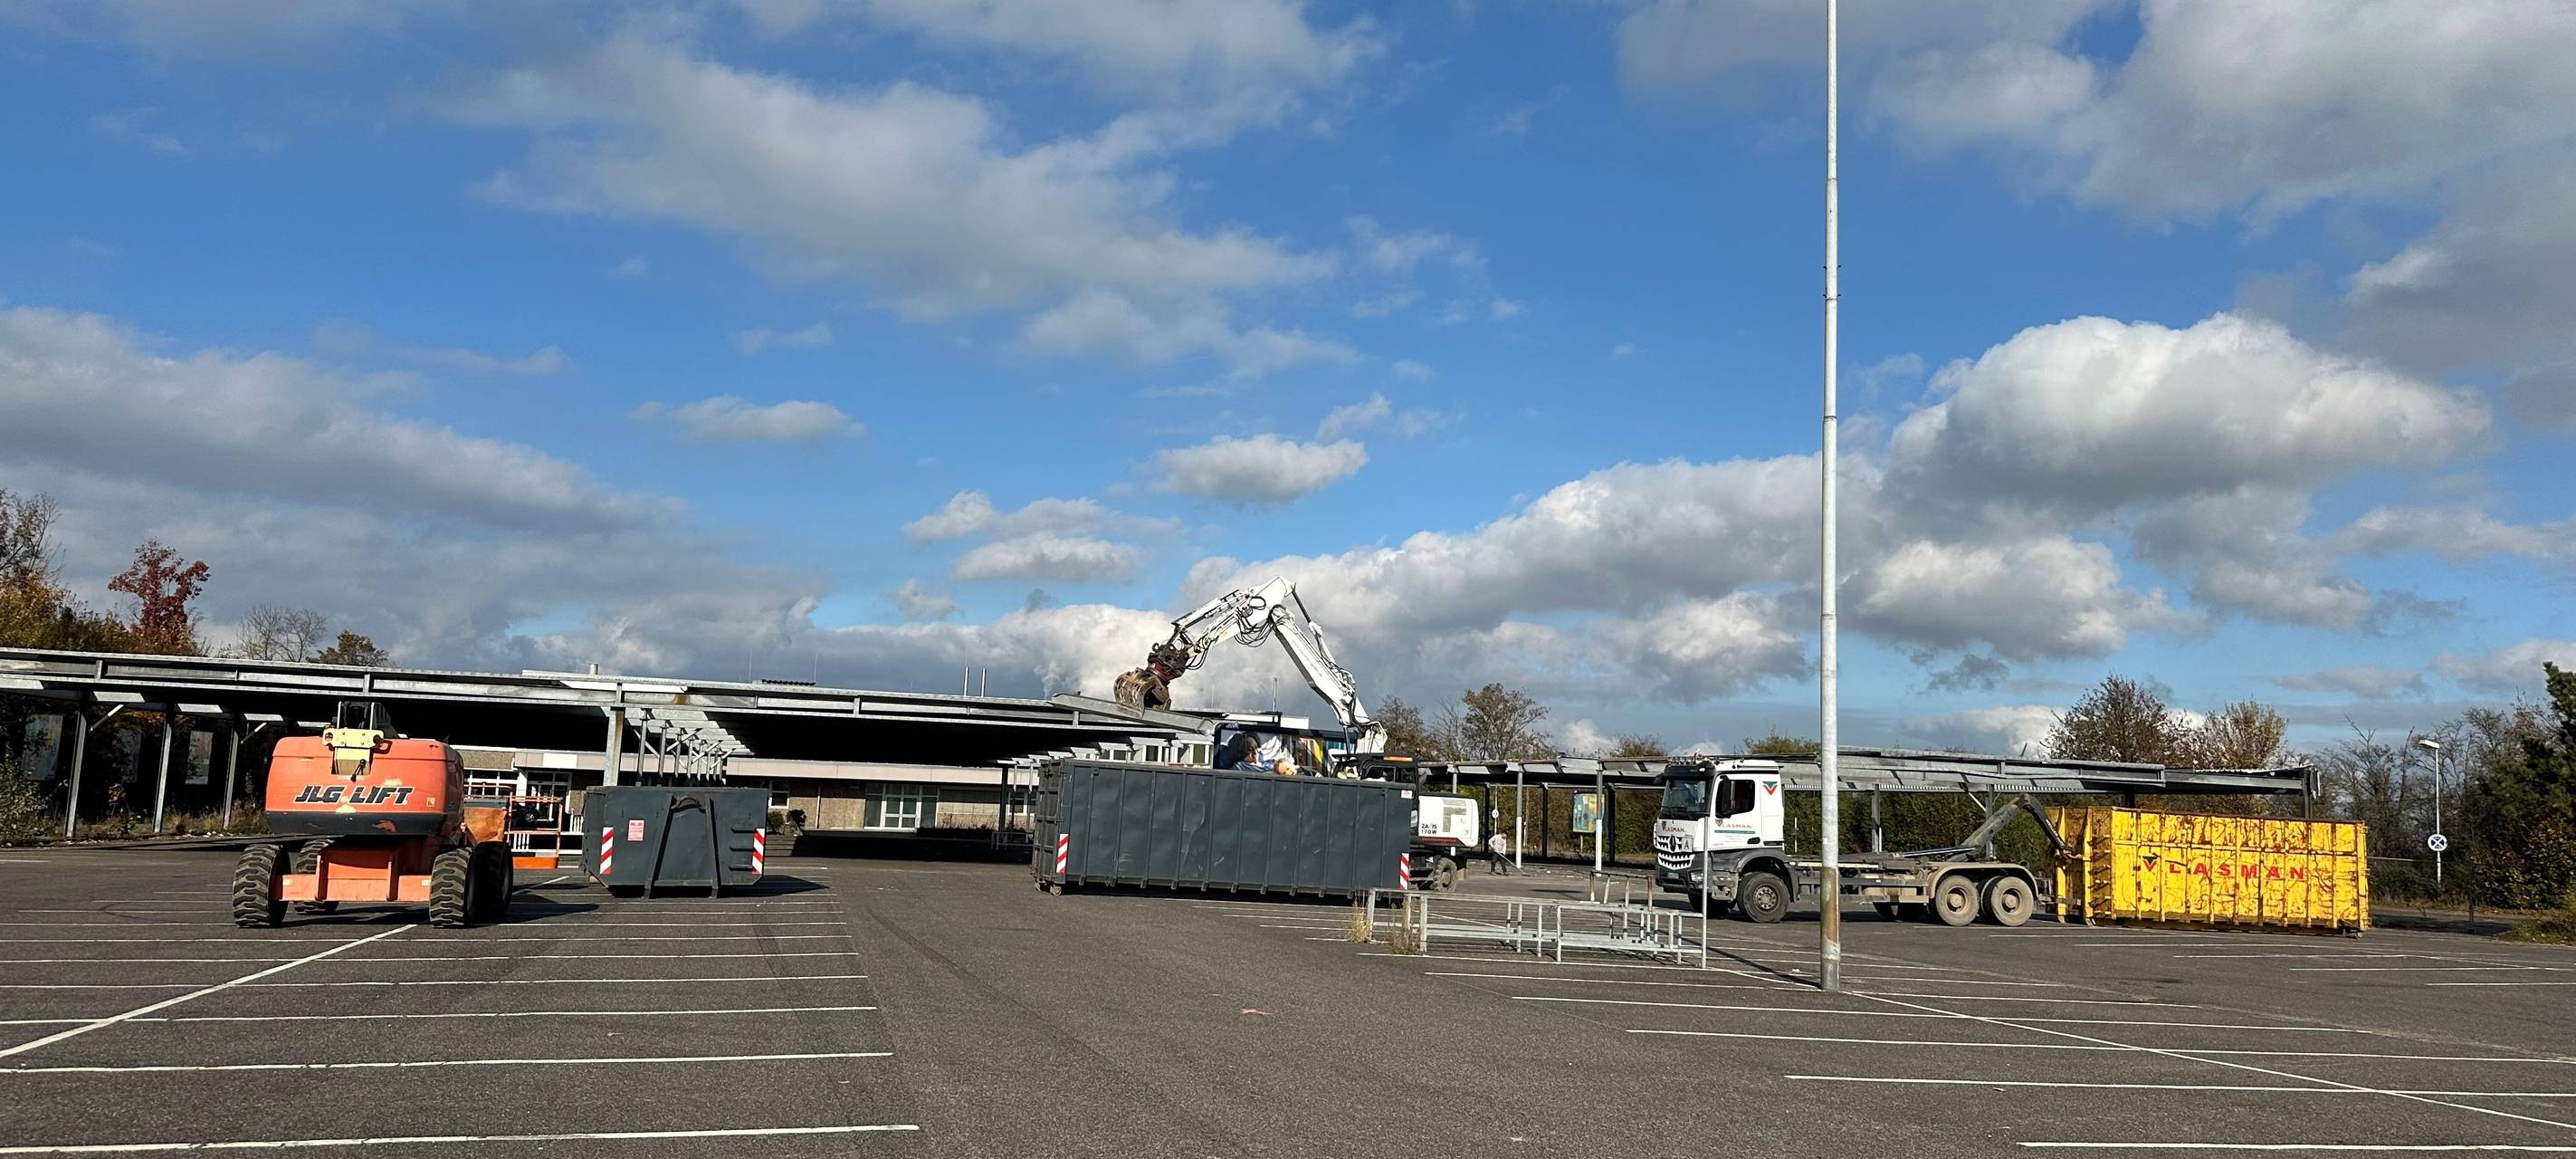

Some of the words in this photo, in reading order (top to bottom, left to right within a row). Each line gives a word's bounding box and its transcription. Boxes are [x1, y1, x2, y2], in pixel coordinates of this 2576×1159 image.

[294, 785, 345, 804] JLG
[348, 786, 414, 805] LIFT
[2142, 856, 2304, 879] VLASMAN
